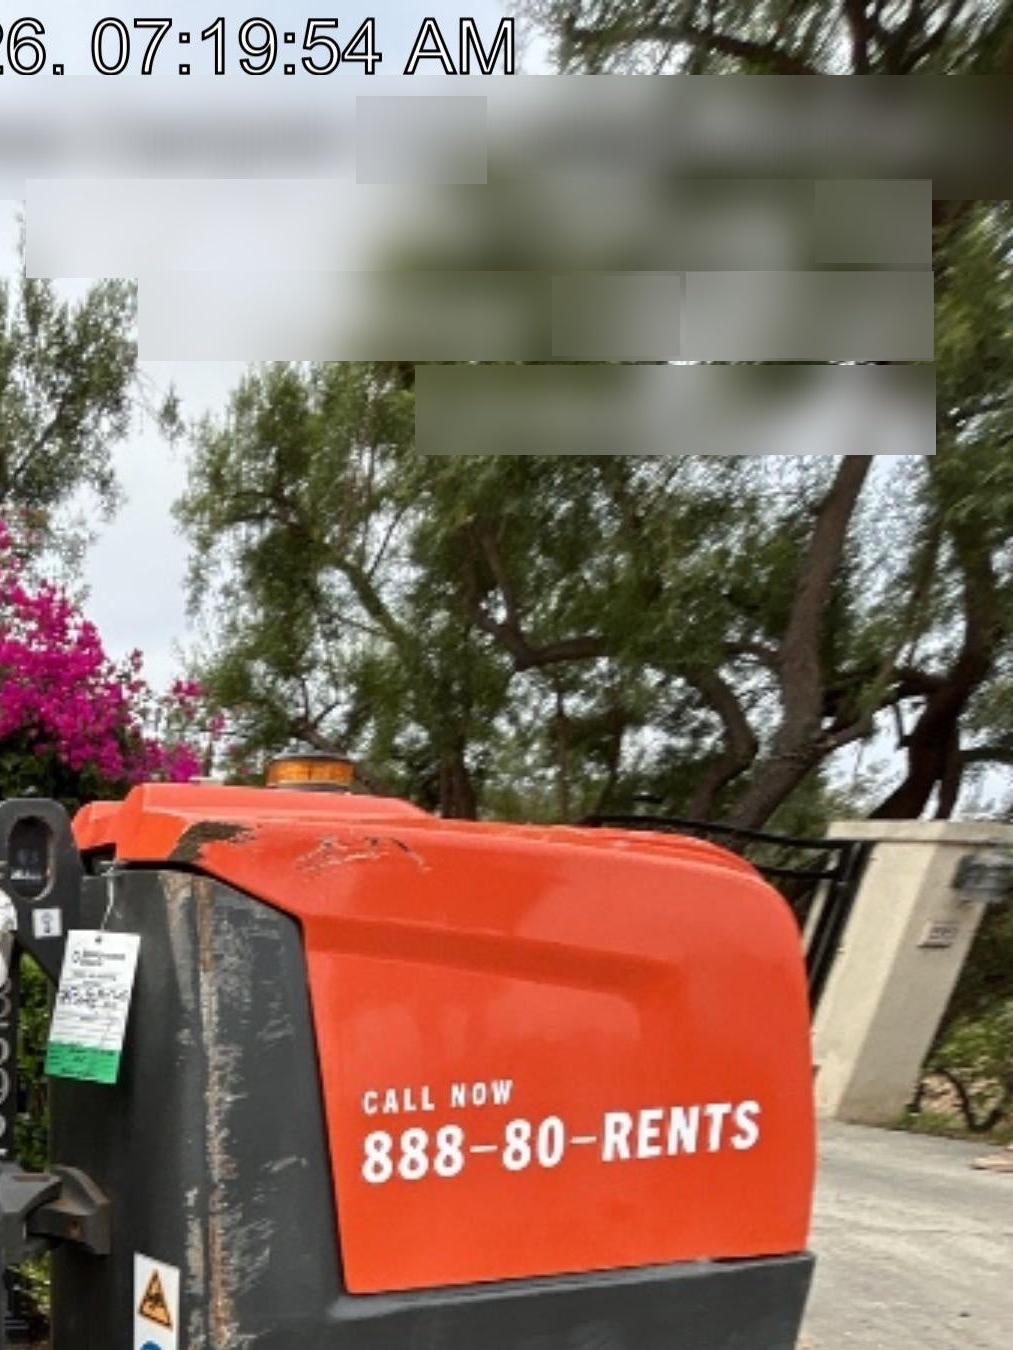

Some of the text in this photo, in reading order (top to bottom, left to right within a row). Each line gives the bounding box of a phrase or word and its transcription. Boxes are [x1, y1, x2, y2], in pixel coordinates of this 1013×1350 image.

[362, 1079, 514, 1115] CALL NOW
[361, 1100, 762, 1184] 888-80-RENTS
